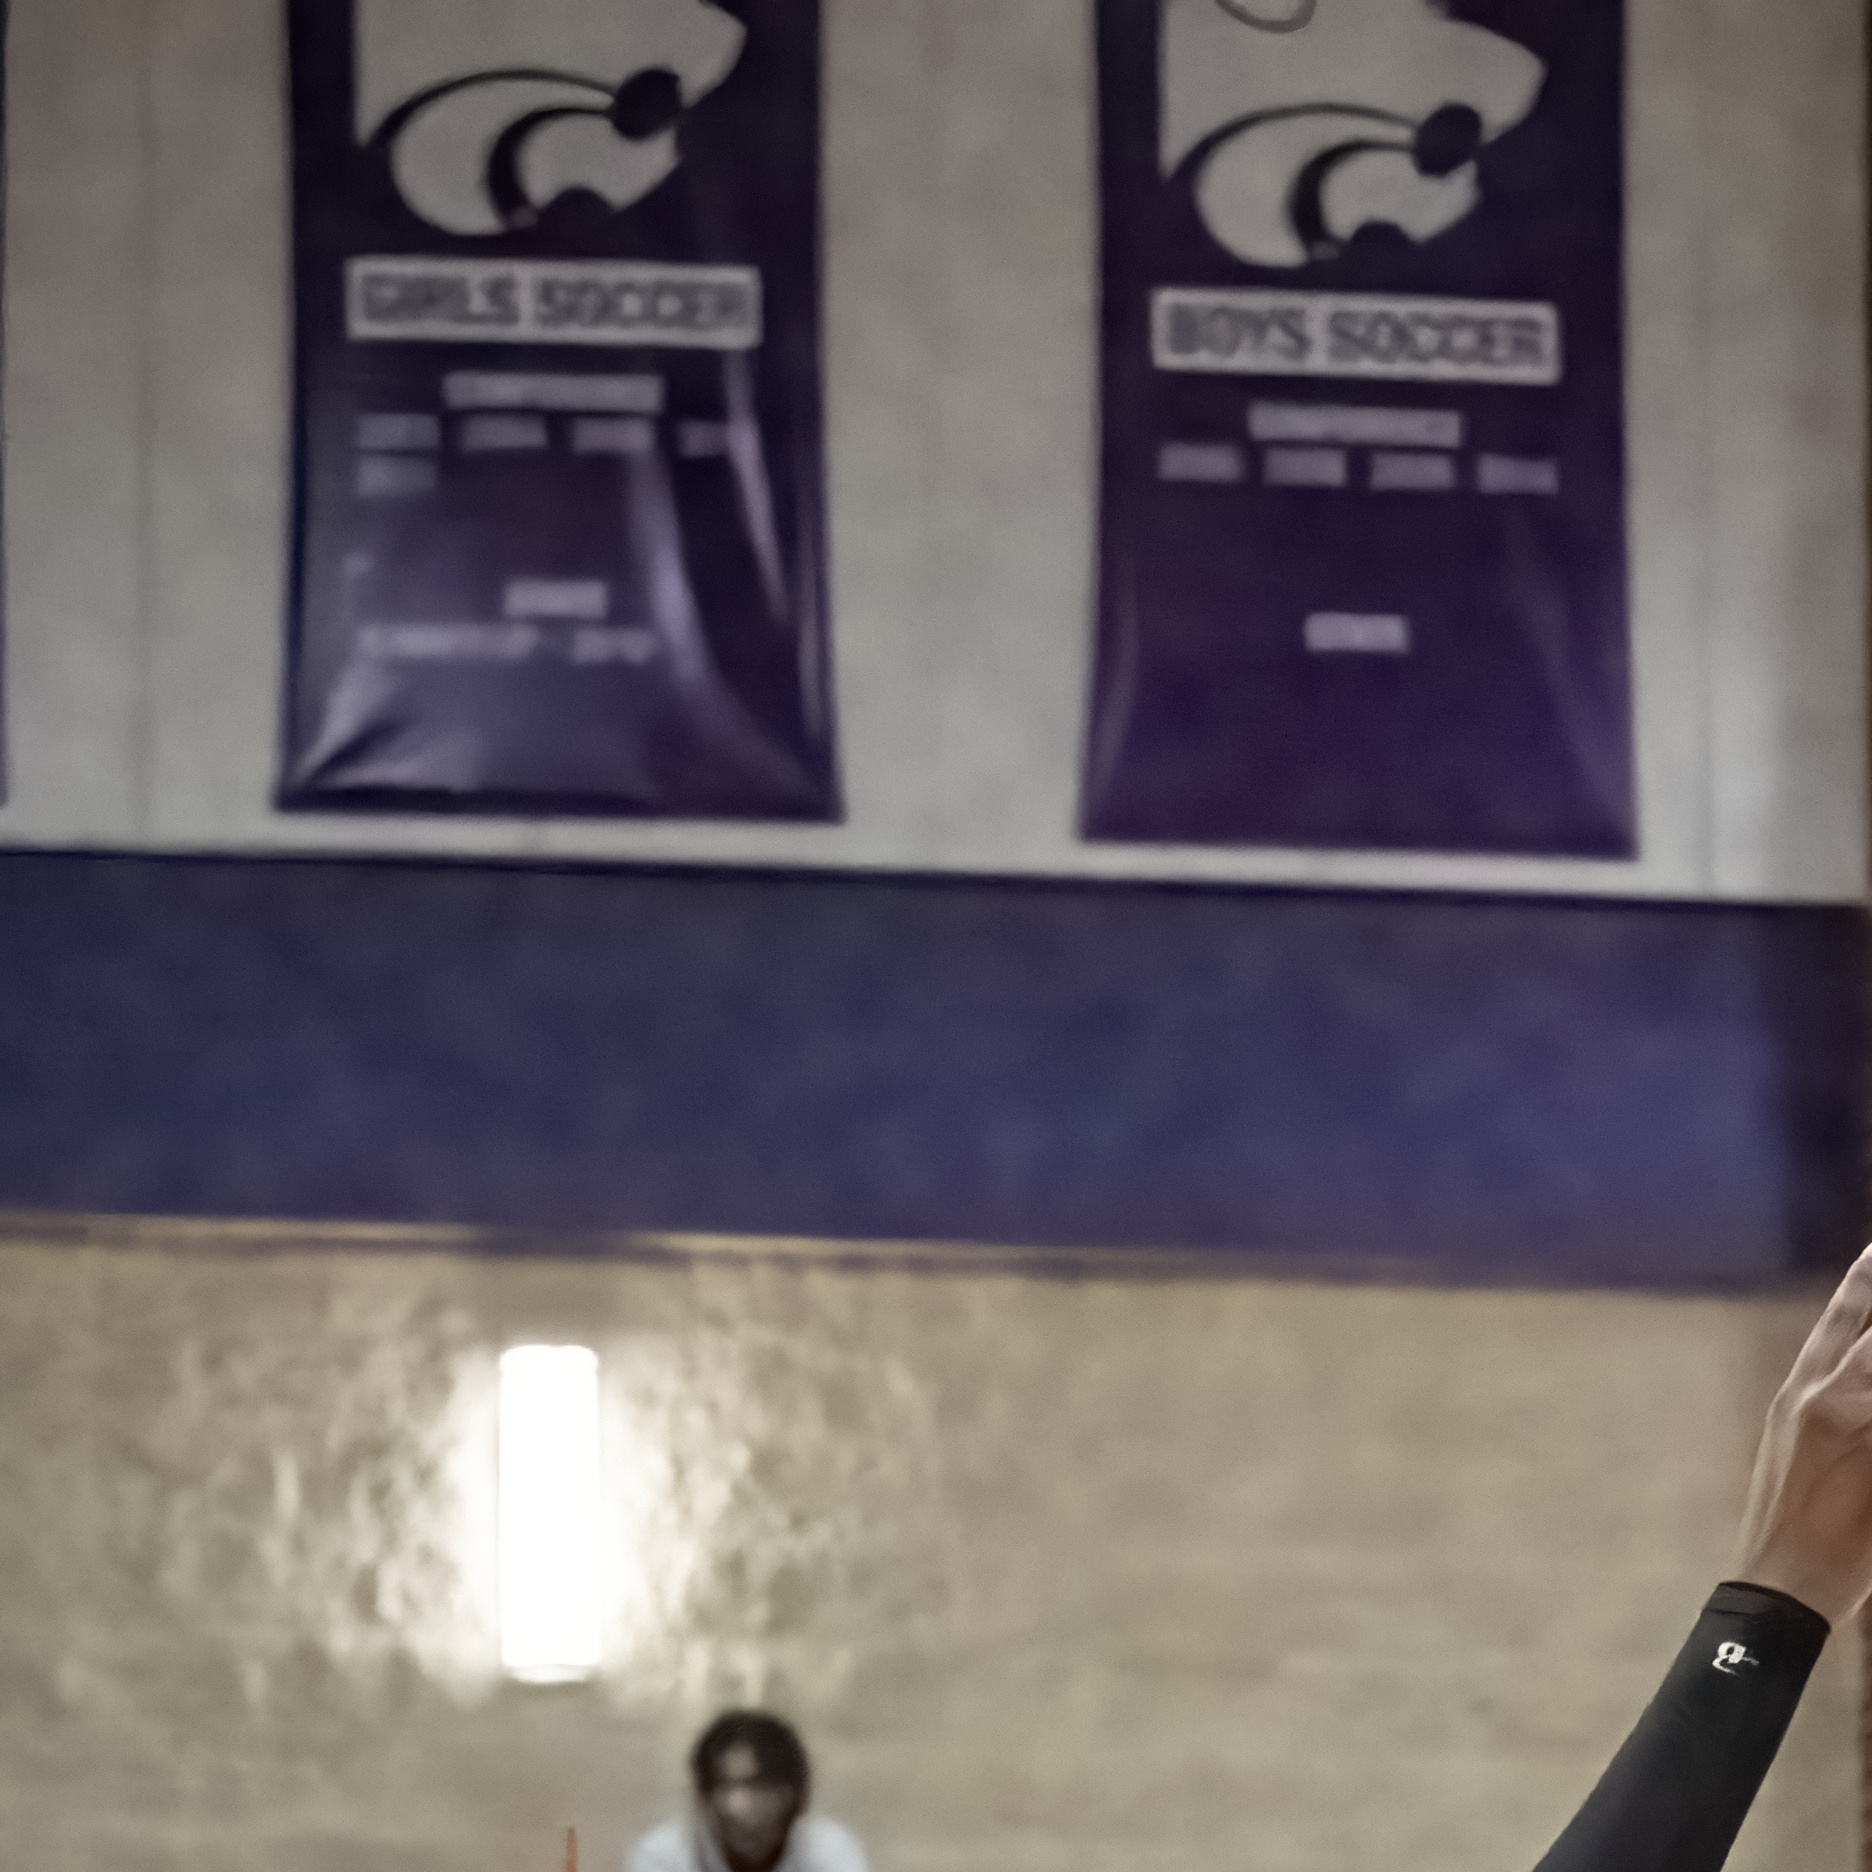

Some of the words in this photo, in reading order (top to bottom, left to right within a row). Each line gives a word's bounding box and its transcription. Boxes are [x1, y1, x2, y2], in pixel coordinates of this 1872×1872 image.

[533, 276, 750, 333] SOCCER
[1168, 303, 1309, 358] BOYS
[1327, 309, 1547, 366] SOCCER
